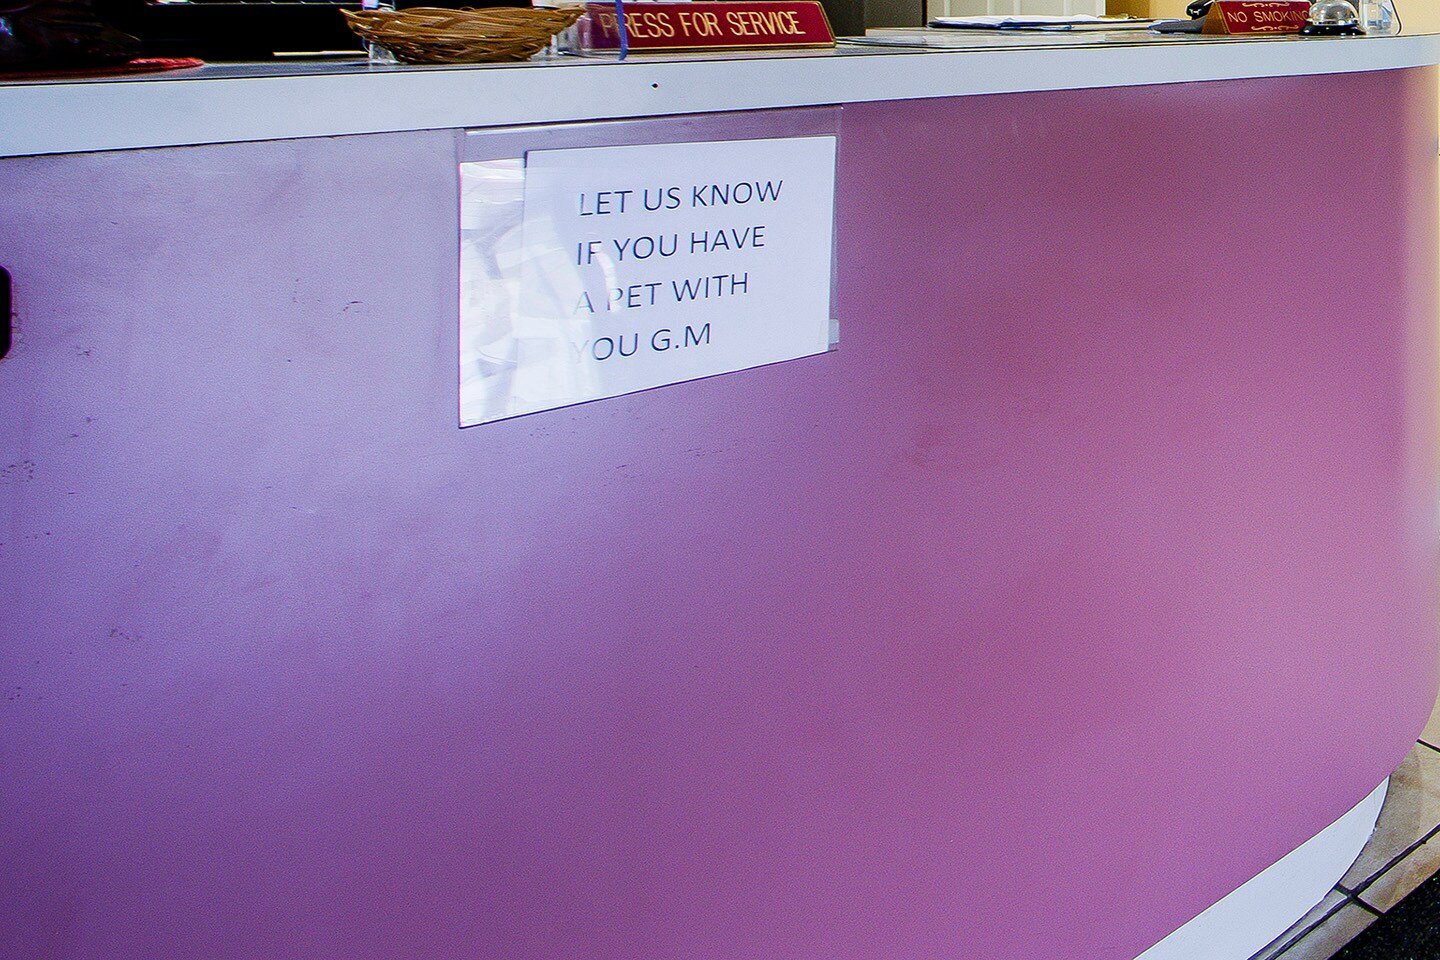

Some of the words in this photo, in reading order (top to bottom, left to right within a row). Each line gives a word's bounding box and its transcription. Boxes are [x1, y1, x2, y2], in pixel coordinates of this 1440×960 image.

[599, 13, 675, 38] PRESS
[679, 12, 723, 37] FOR
[727, 11, 806, 37] SERVICE
[1227, 11, 1248, 23] NO
[579, 190, 633, 217] LET
[643, 187, 681, 211] US
[691, 179, 783, 208] KNOW
[576, 241, 602, 266] IF
[612, 233, 678, 262] YOU
[690, 226, 766, 254] HAVE
[574, 290, 595, 315] A
[606, 283, 662, 311] PET
[671, 272, 749, 302] WITH
[650, 322, 712, 352] G.M
